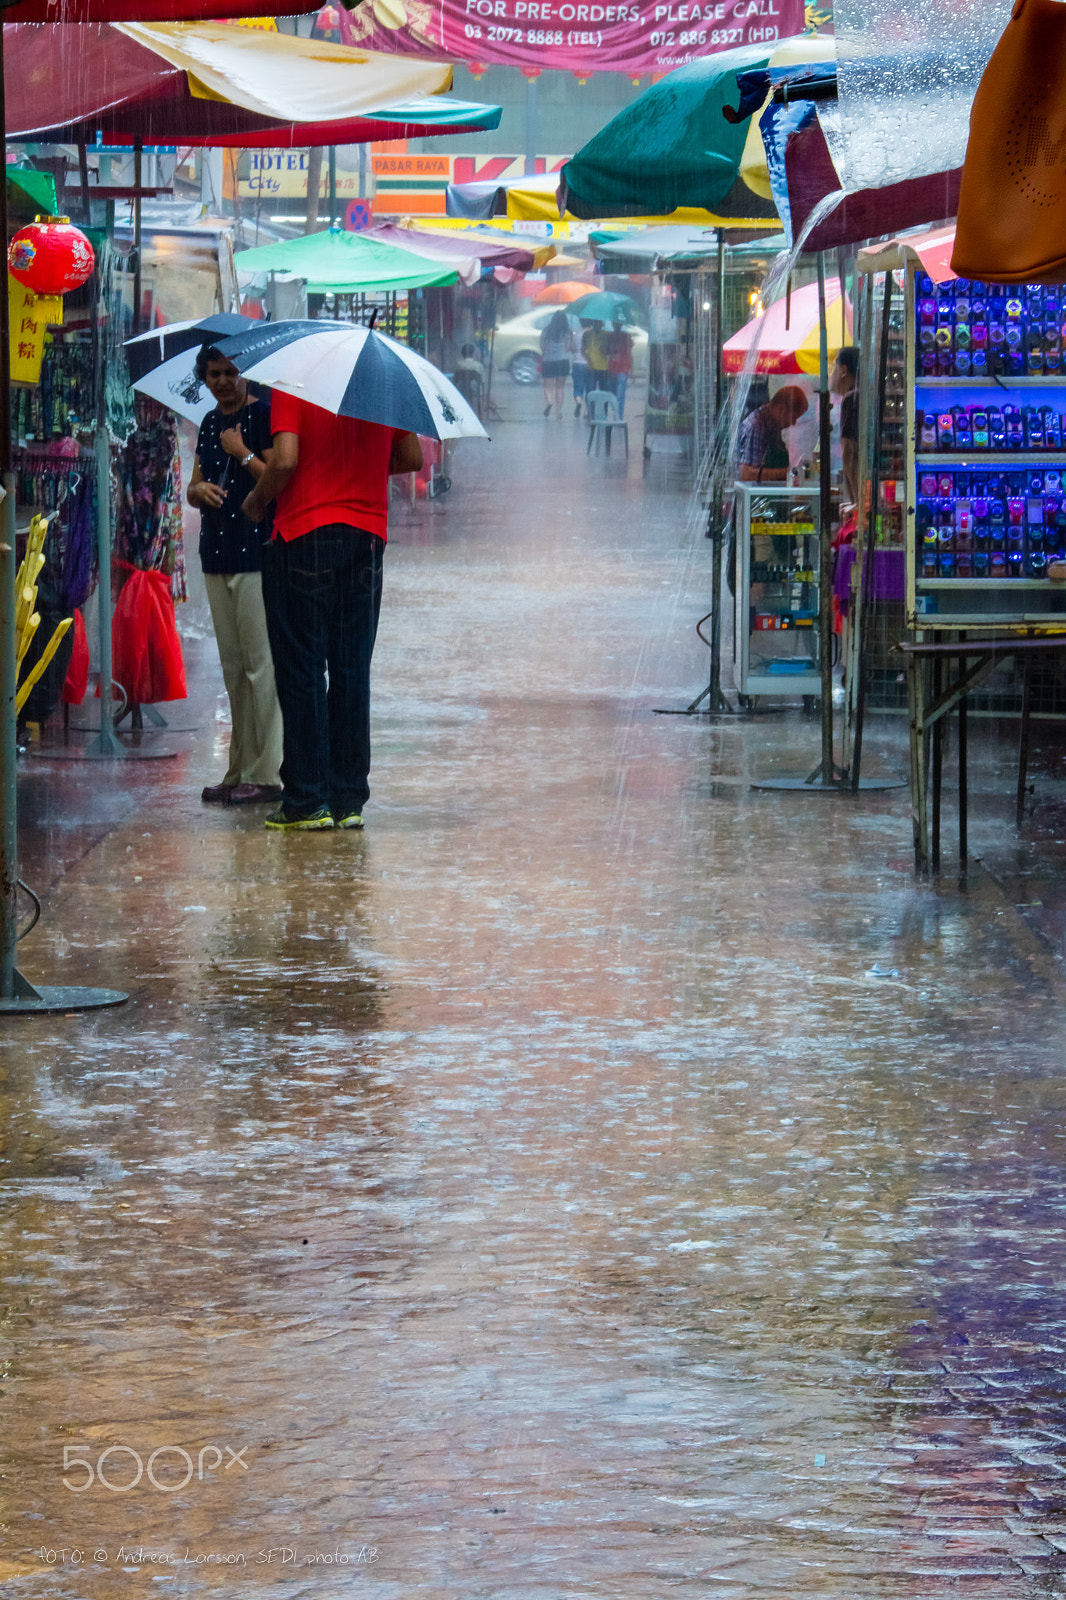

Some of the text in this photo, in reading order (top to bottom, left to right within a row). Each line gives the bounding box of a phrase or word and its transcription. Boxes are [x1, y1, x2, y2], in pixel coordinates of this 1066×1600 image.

[466, 0, 780, 26] FOR PRE-ORDERS, PLEASE CALL
[464, 24, 602, 47] 03 2072 8888 (TEL)
[680, 30, 707, 46] 886
[748, 25, 779, 43] (HP)
[249, 154, 309, 170] HOTEL
[375, 160, 445, 171] PASAR RAYA
[248, 176, 281, 193] City
